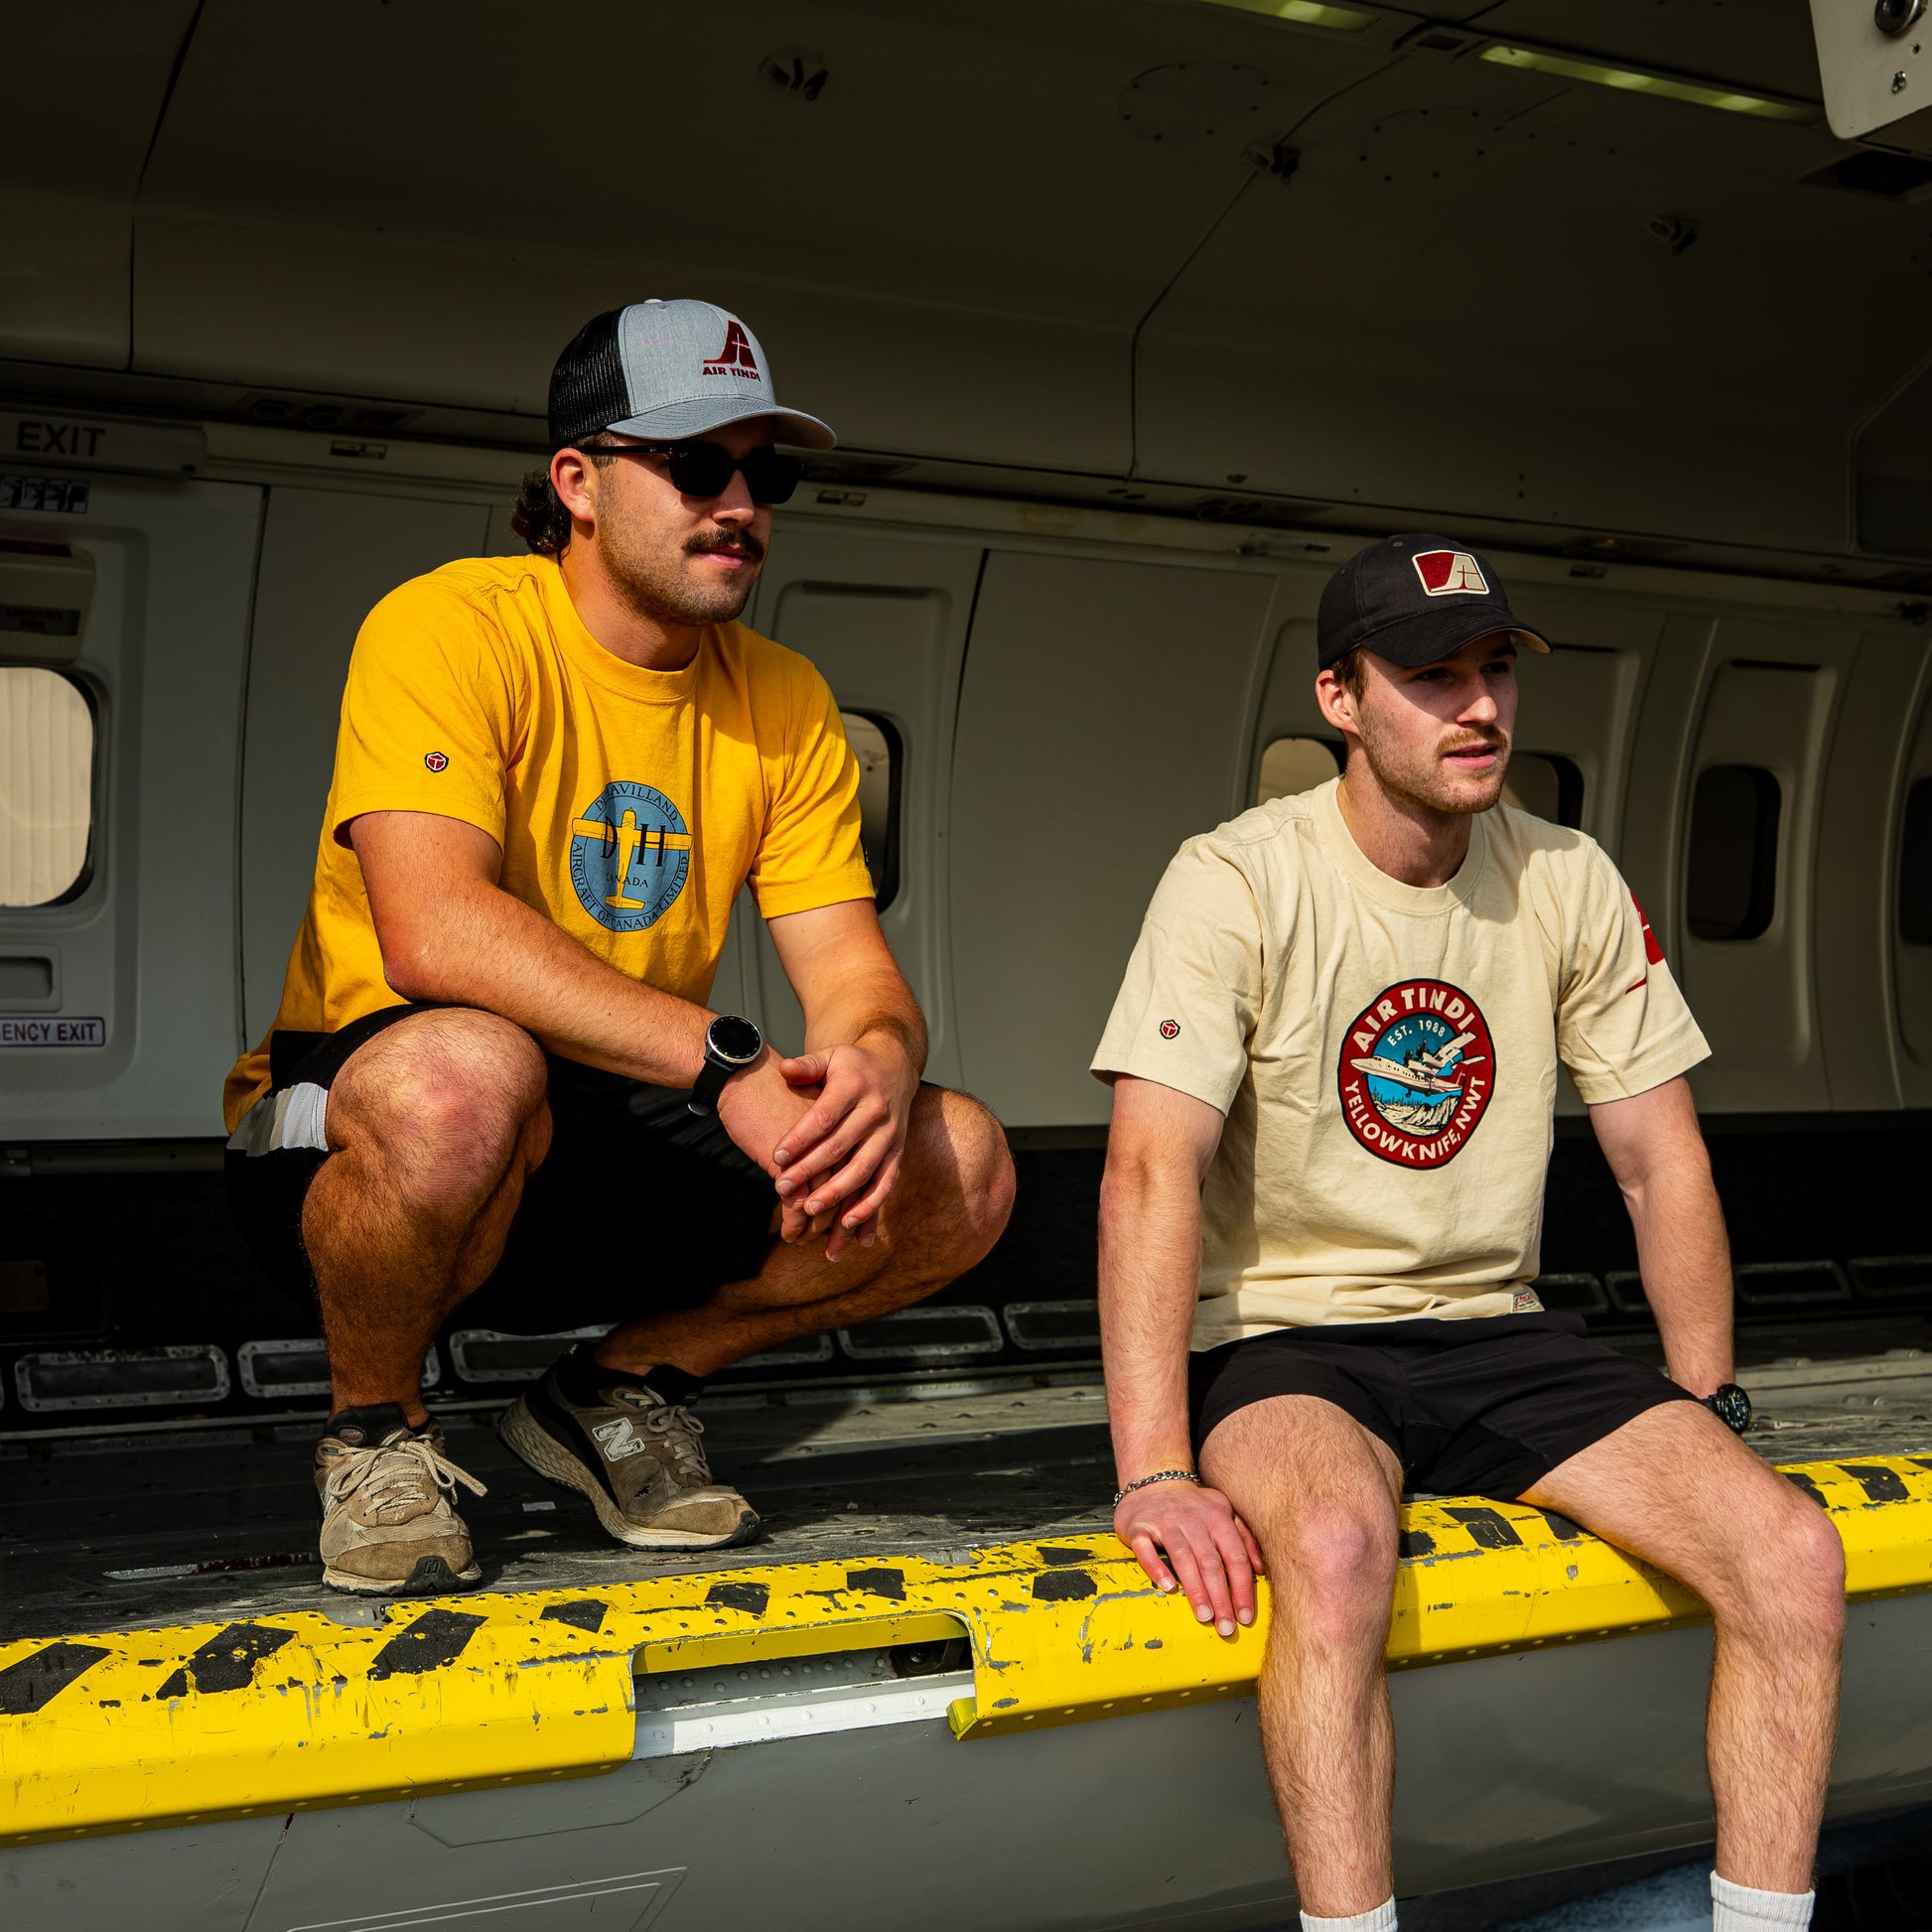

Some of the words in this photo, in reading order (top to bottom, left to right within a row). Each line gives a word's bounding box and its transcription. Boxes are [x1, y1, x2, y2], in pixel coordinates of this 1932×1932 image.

[702, 365, 728, 376] AIR
[729, 366, 762, 383] TINDI
[18, 421, 106, 457] EXIT
[571, 842, 599, 911] AIRCRAFT
[597, 909, 611, 924] OF
[611, 911, 658, 930] CANADA
[658, 856, 689, 912] LIMITED
[606, 872, 649, 889] CANADA
[0, 1023, 51, 1041] ENCY
[57, 1023, 96, 1041] EXIT
[1352, 998, 1398, 1053] AIR
[1400, 987, 1476, 1032] TINDI
[1387, 1025, 1414, 1047] EST.
[1418, 1020, 1447, 1038] 1988
[1344, 1079, 1461, 1161] YELLOWKNIFE,
[1454, 1076, 1486, 1131] NWT
